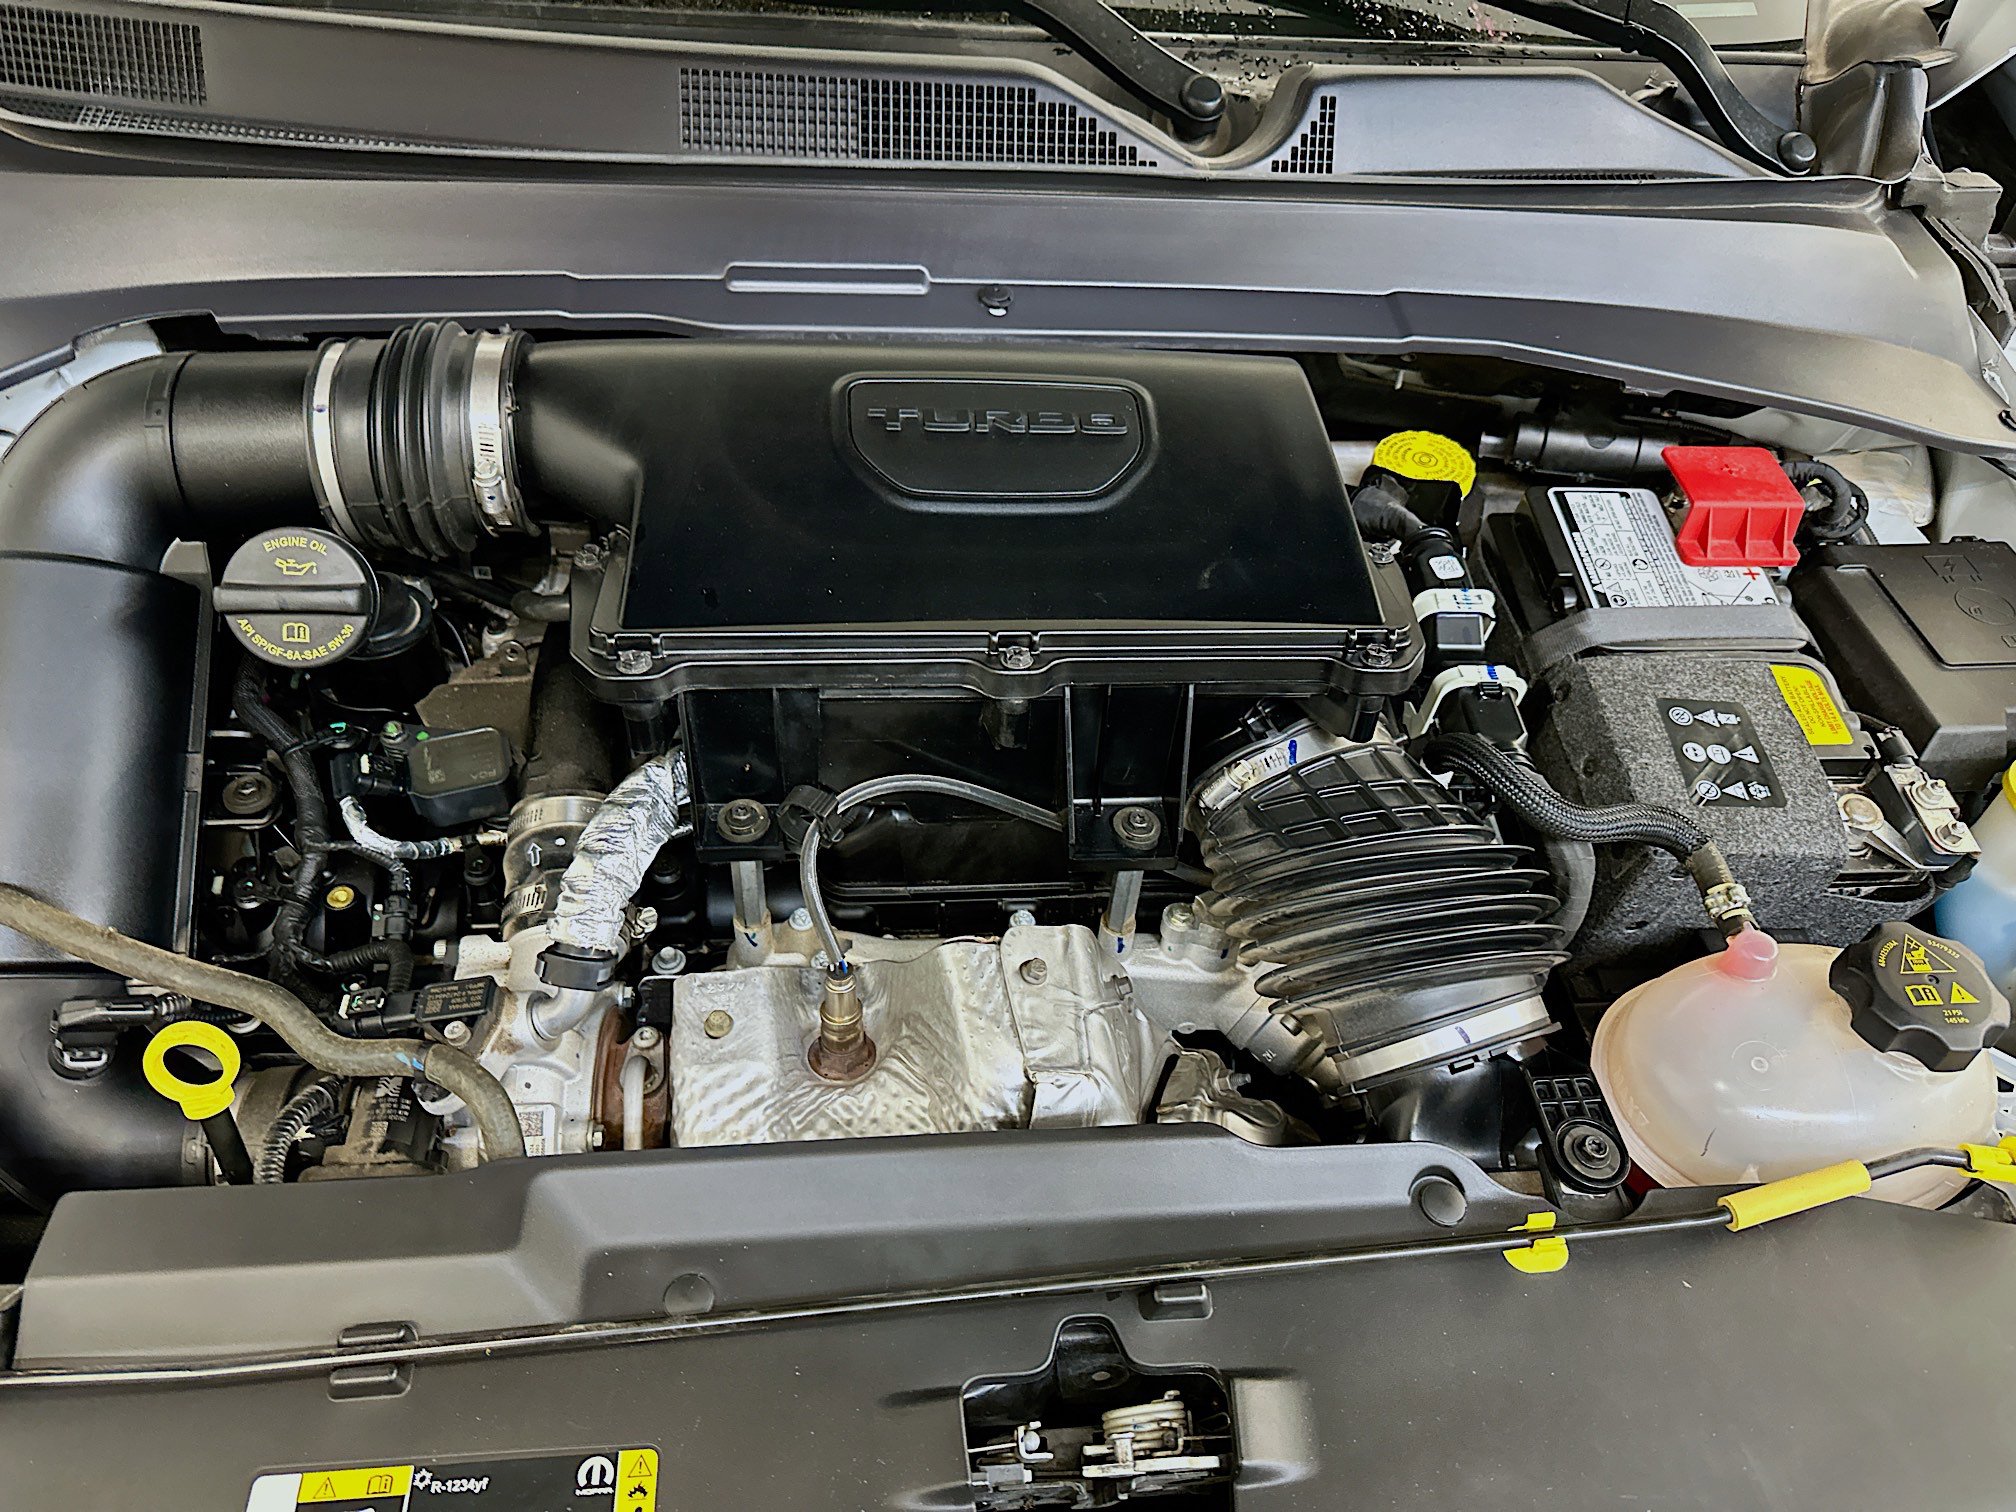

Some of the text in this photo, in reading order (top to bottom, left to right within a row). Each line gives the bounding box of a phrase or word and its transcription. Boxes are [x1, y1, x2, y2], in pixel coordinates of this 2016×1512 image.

[867, 408, 1128, 435] TURBO
[262, 536, 329, 555] ENGINE OIL
[236, 618, 256, 638] API
[327, 623, 355, 653] 5W-30
[430, 1476, 489, 1495] R-1234yf
